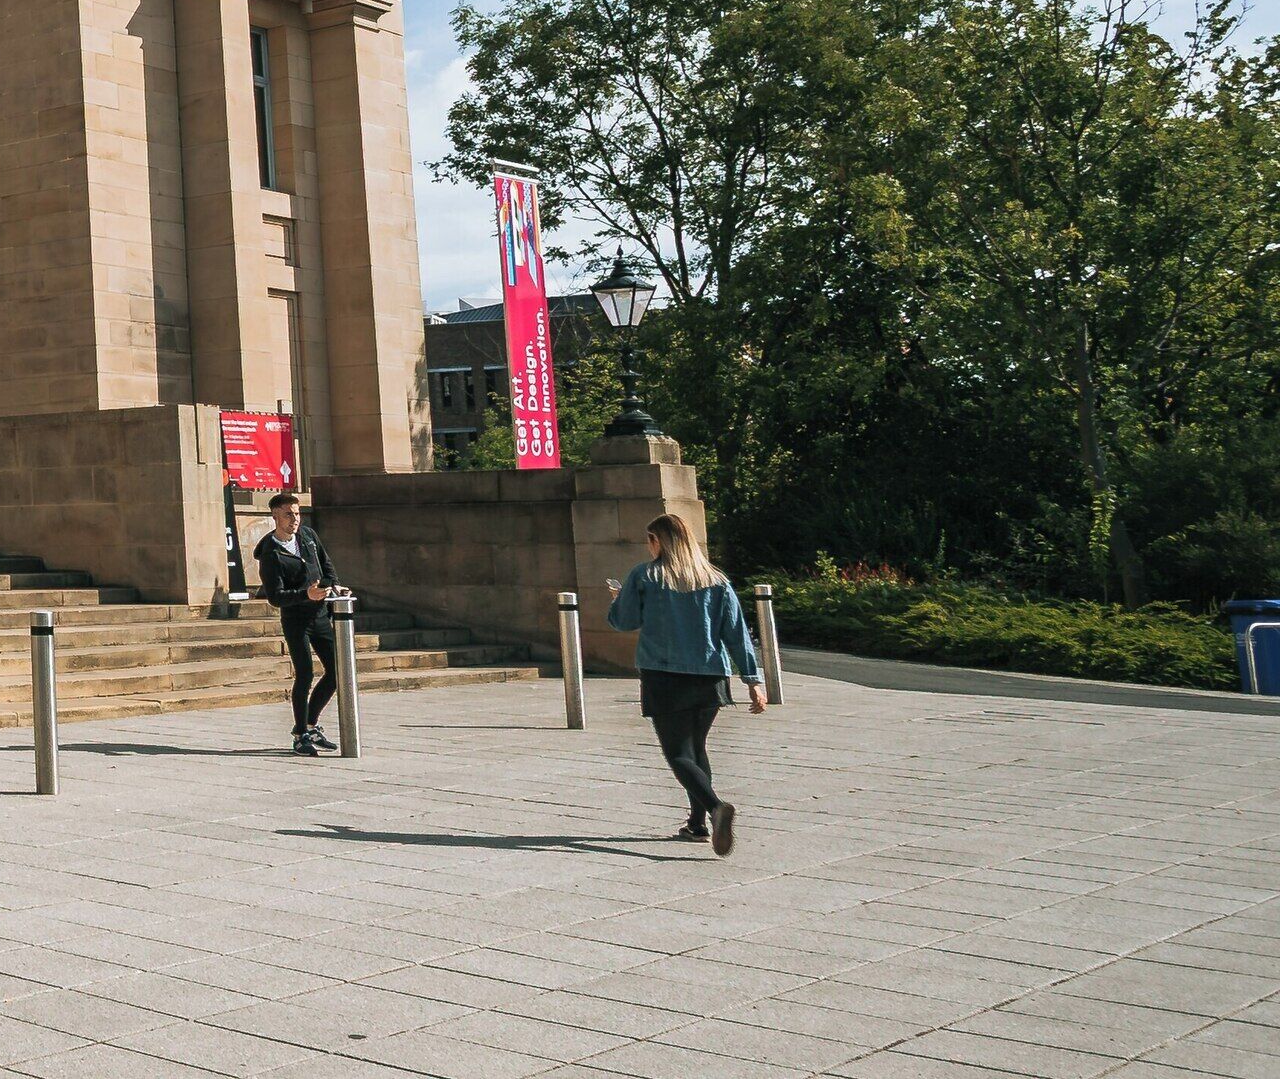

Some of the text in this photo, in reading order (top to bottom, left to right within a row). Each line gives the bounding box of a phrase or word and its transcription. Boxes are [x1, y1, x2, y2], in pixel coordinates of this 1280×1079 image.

[512, 371, 529, 457] Get Art.
[525, 340, 542, 458] Get Design.
[536, 307, 555, 458] Get Innovation.
